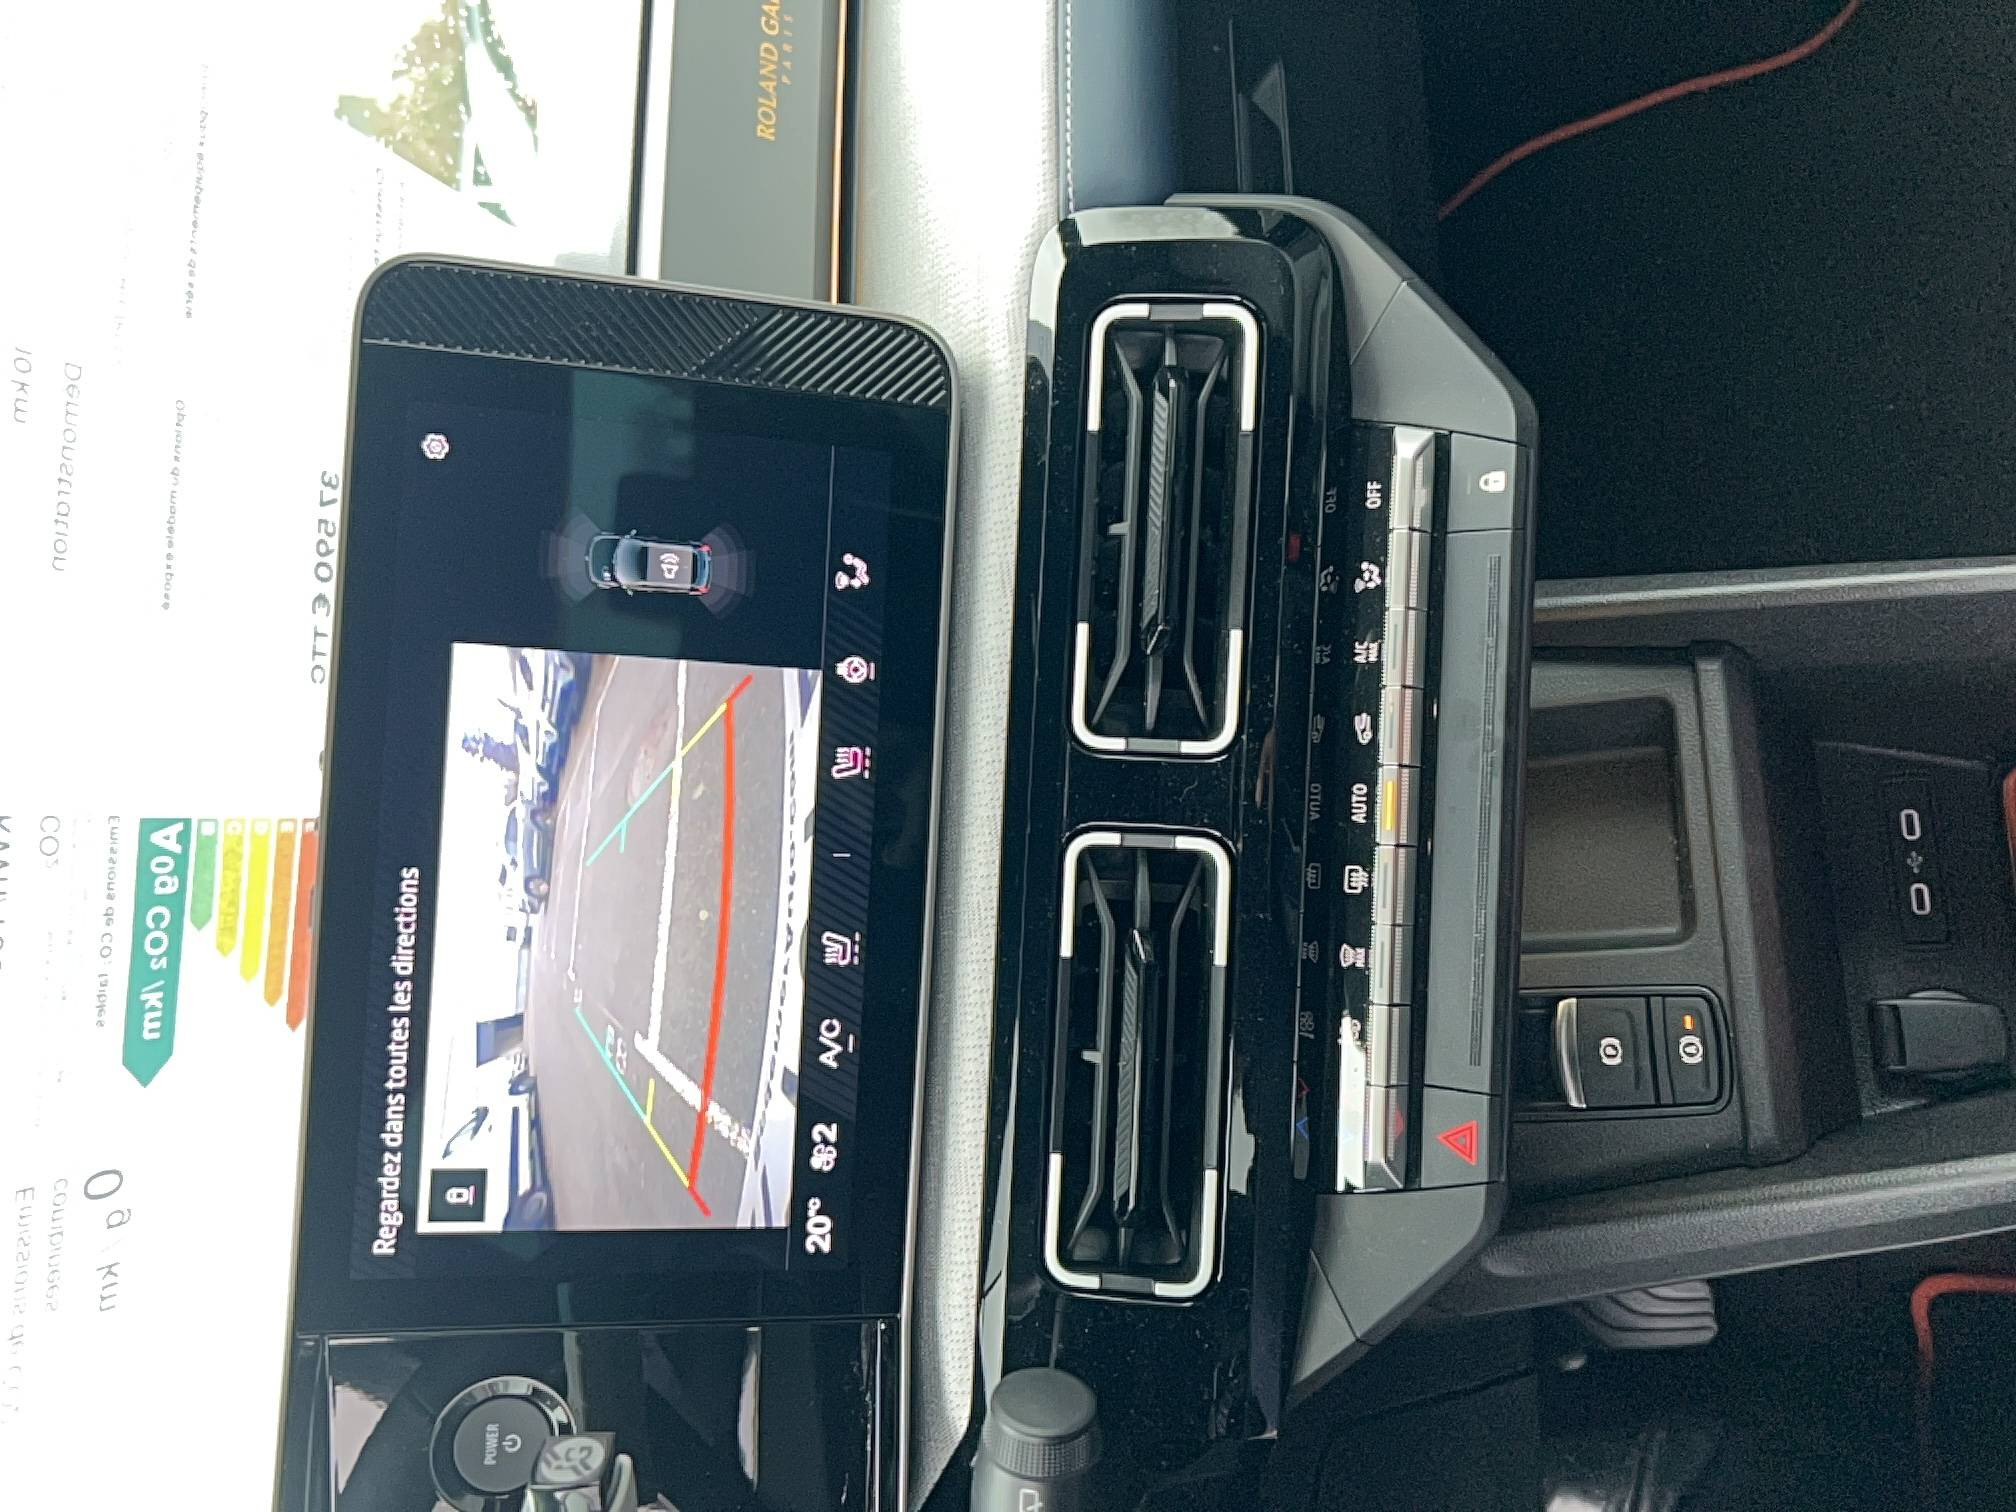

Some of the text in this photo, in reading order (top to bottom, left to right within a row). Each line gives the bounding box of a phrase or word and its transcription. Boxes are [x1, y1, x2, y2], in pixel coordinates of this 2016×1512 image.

[755, 0, 782, 142] ROLAND GA
[781, 14, 794, 86] PARIS
[1364, 480, 1382, 510] OFF
[1353, 640, 1369, 664] A/C
[1350, 782, 1369, 824] AUTO
[371, 866, 421, 1256] Regardez dans toutes les directions
[817, 1017, 843, 1070] A/C
[810, 1121, 839, 1144] 2
[483, 1422, 500, 1466] POWER
